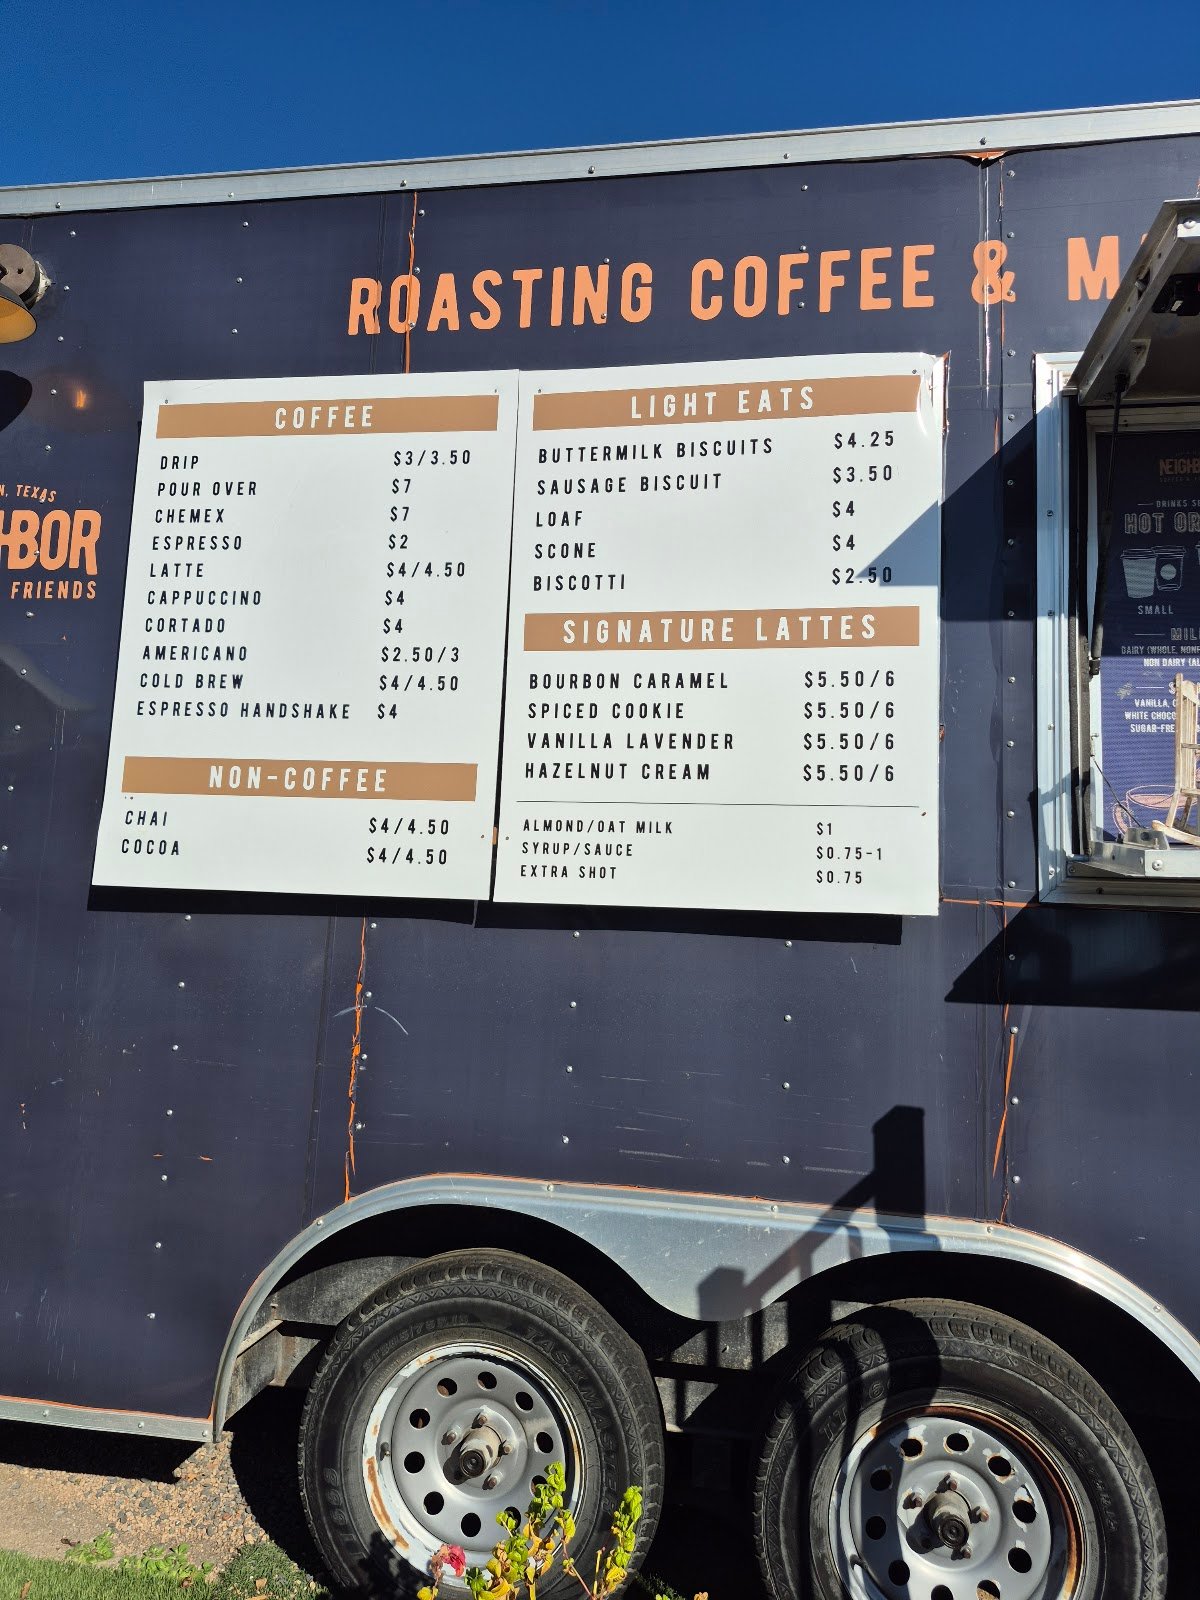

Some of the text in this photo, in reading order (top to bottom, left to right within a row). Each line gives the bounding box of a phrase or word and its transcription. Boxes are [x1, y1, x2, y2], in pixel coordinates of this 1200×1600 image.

[348, 233, 1149, 335] ROASTING COFFEE & M
[631, 386, 813, 419] LIGHT EATS
[275, 405, 373, 430] COFFEE
[538, 430, 894, 464] BUTTERMILK BISCUITS $4.25
[160, 449, 471, 470] DRIP $3/3.50
[157, 478, 412, 497] POUR OVER $7
[537, 464, 892, 496] SAUSAGE BISCUIT $3.50
[16, 484, 57, 503] TEXAS
[1156, 499, 1188, 508] DRINKS
[154, 505, 410, 524] CHEMEX $7
[535, 500, 855, 528] LOAF $4
[1124, 511, 1200, 534] HOT OR
[152, 533, 409, 551] ESPRESSO $2
[534, 534, 856, 560] SCONE $4
[149, 561, 465, 578] LATTE $4/4.50
[533, 566, 892, 592] BISCOTTI $2.50
[10, 580, 97, 599] FRIENDS
[147, 589, 405, 607] CAPPUCCINO $4
[1137, 605, 1174, 615] SMALL
[145, 617, 403, 635] CORTADO $4
[563, 613, 875, 644] SIGNATURE LATTES
[1170, 627, 1200, 641] MIL
[142, 645, 459, 664] AMERICANO $2.50/3
[1121, 645, 1144, 655] DAIRY
[1162, 658, 1185, 667] DAIRY
[140, 672, 459, 692] COLD BREW $4/4.50
[529, 669, 895, 690] BOURBON CARAMEL $5.50/6
[136, 700, 398, 720] ESPRESSO HANDSHAKE $4
[527, 700, 894, 720] SPICED COOKIE $5.50/6
[1124, 711, 1149, 720] WHITE
[1130, 723, 1176, 733] SUGAR-FRE
[527, 732, 894, 751] VANILLA LAVENDER $5.50/6
[209, 765, 387, 792] NON-COFFEE
[525, 762, 894, 783] HAZELNUT CREAM $5.50/6
[124, 810, 449, 836] CHAI $4/4.50
[523, 818, 832, 836] ALMOND/OAT MILK $1
[121, 838, 447, 865] COCOA $4/4.50
[521, 841, 882, 861] SYRUP/SAUCE $0.75-1
[520, 864, 862, 885] EXTRA SHOT $0.75
